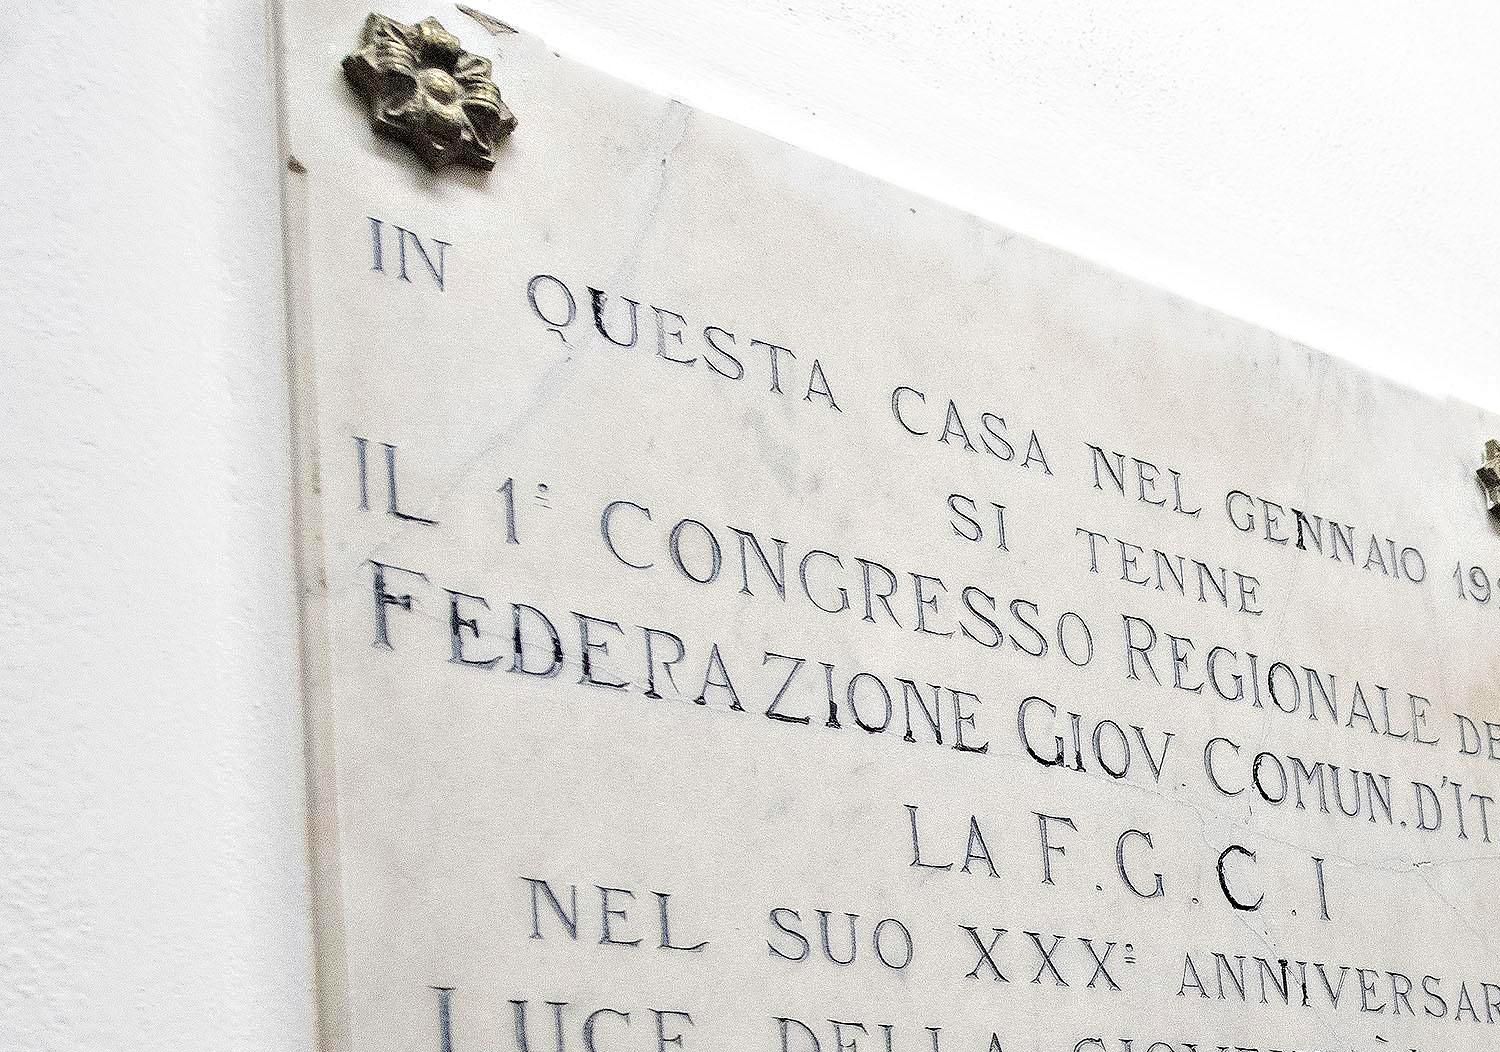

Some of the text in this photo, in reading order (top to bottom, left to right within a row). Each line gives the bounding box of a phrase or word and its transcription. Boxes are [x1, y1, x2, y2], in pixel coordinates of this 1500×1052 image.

[367, 216, 451, 292] IN
[527, 275, 842, 412] QUESTA
[891, 386, 1054, 477] CASA
[1085, 442, 1202, 518] NEL
[1225, 490, 1427, 584] GENNAIO
[352, 436, 440, 526] IL
[600, 500, 1094, 667] CONGRESSO
[1122, 614, 1440, 745] REGIONALE
[947, 493, 1263, 617] SI TENNE
[365, 559, 989, 755] FEDERAZIONE
[903, 803, 1001, 879] LA
[520, 876, 710, 953] NEL
[766, 907, 914, 970] SUO
